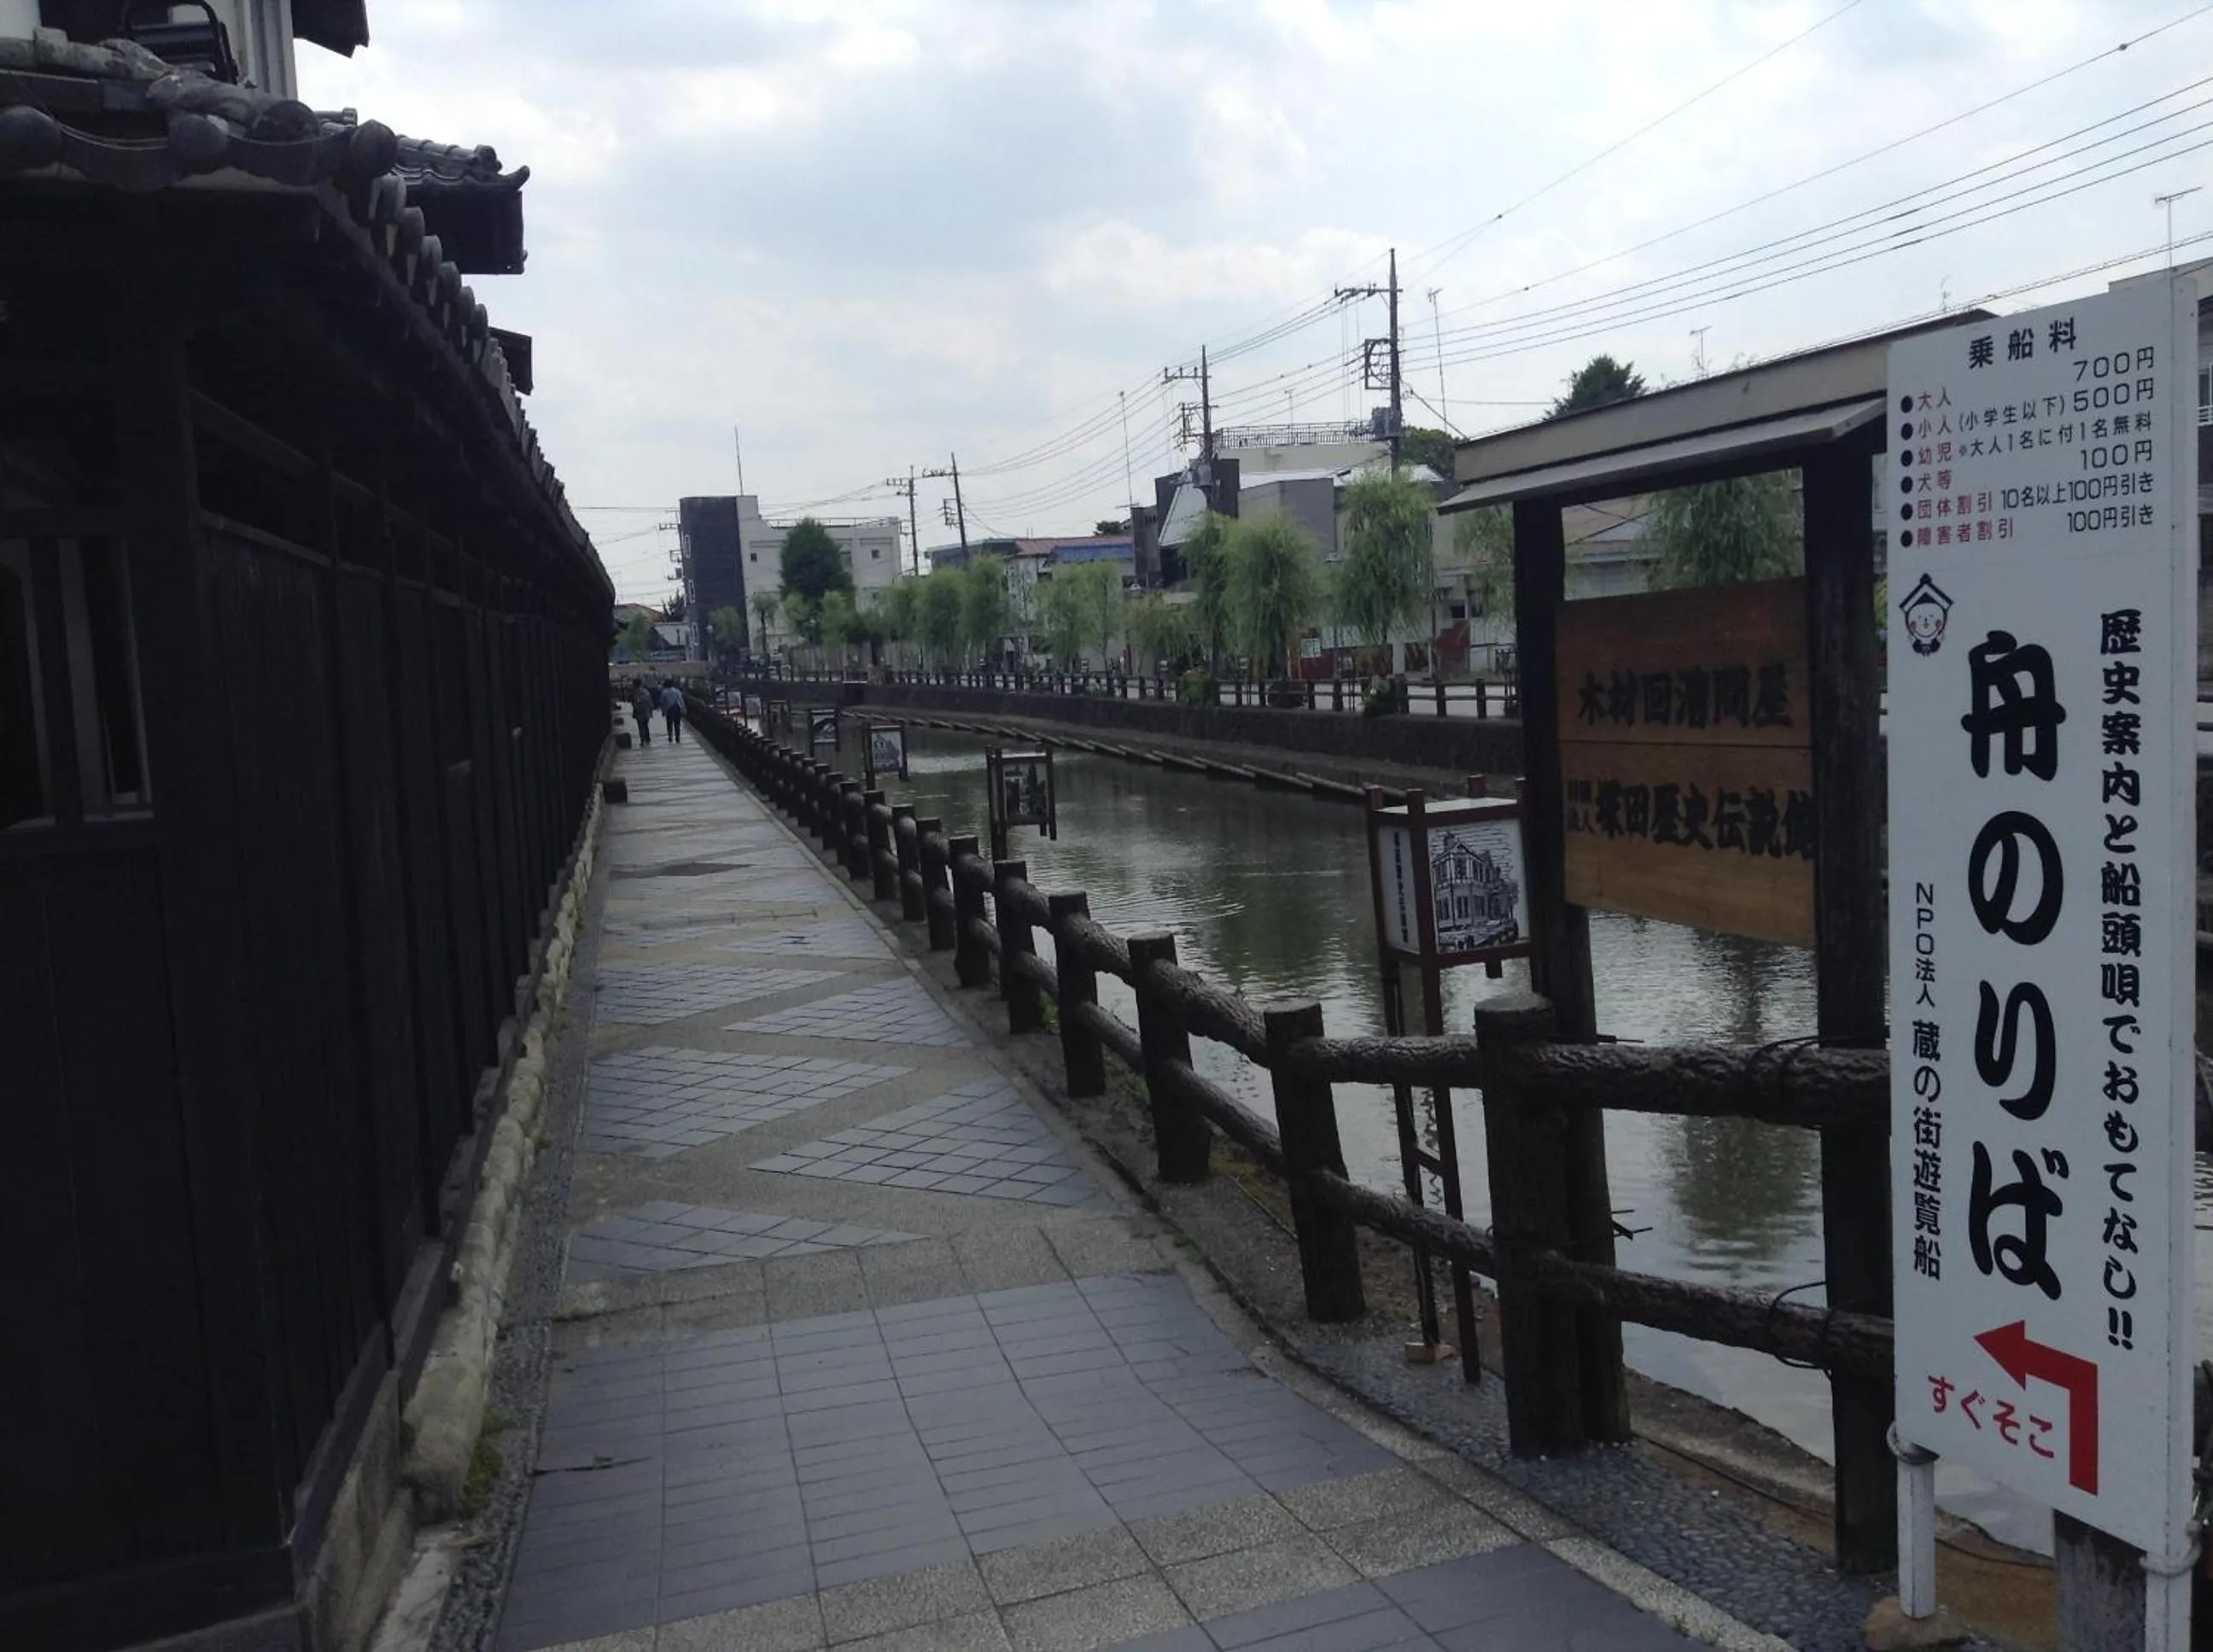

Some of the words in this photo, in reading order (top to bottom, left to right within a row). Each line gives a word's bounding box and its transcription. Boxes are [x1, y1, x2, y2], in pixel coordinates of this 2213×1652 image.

[1968, 317, 2076, 369] 乗船料
[1917, 387, 1952, 412] 大人
[2073, 346, 2154, 382] 700円
[1918, 414, 1952, 439] 小人
[2073, 377, 2154, 412] 500円
[1917, 470, 1953, 493] 犬等
[2080, 439, 2153, 470] 100円
[1918, 442, 1953, 466] 幼児
[1917, 492, 1993, 520] 団体割引
[1917, 517, 2014, 547] 障害者割引
[2066, 504, 2154, 534] 100円引き
[1915, 883, 1936, 1008] NPO法人
[1960, 629, 2070, 1300] 舟のりば
[1912, 1020, 1941, 1281] 蔵の街遊覧船
[1927, 1375, 2055, 1459] すぐそこ
